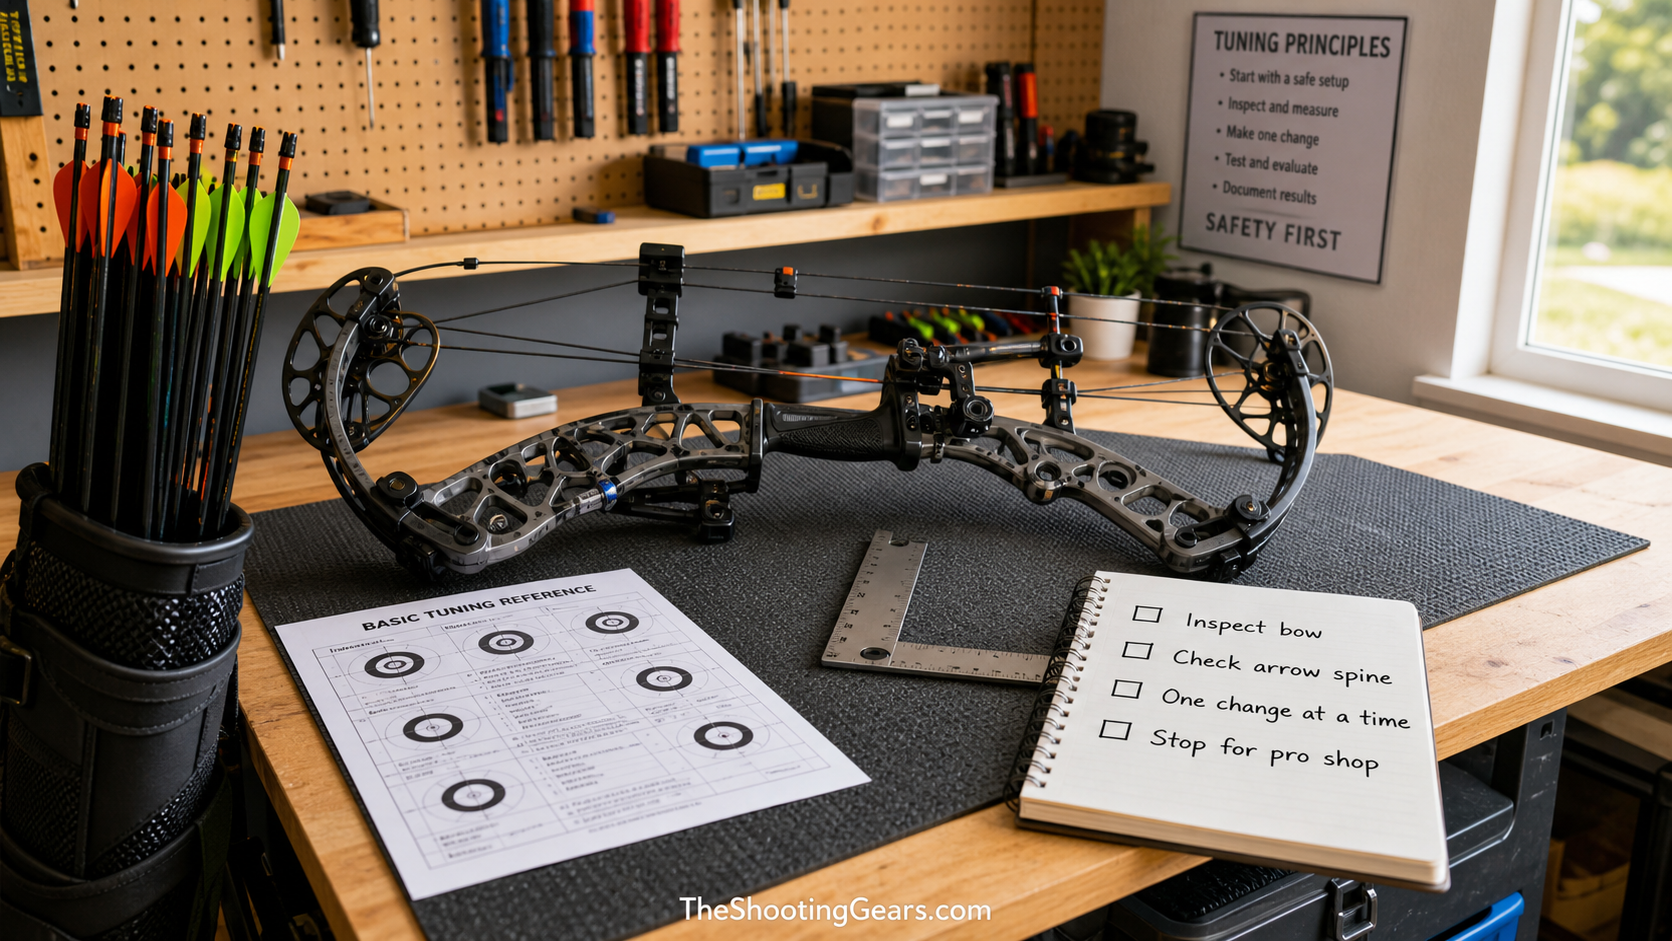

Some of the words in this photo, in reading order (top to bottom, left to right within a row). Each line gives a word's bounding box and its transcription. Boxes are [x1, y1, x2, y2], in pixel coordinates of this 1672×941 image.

[1214, 30, 1278, 53] TUNING
[1285, 33, 1390, 58] PRINCIPLES
[1230, 68, 1255, 83] Start
[1258, 70, 1281, 84] with
[1284, 75, 1290, 84] a
[1294, 72, 1316, 86] safe
[1319, 75, 1349, 91] setup
[1228, 97, 1266, 114] Inspect
[1269, 100, 1289, 114] and
[1292, 104, 1339, 117] measure
[1227, 125, 1254, 140] Make
[1258, 131, 1277, 142] one
[1280, 130, 1319, 149] change
[1225, 153, 1246, 167] Test
[1249, 157, 1269, 170] and
[1272, 159, 1318, 175] evaluate
[1223, 180, 1276, 200] Document
[1280, 190, 1316, 205] results
[1206, 212, 1276, 240] SAFETY
[1284, 224, 1341, 250] FIRST
[362, 614, 420, 631] BASIC
[424, 600, 496, 619] TUNING
[499, 585, 597, 606] REFERENCE
[1187, 613, 1266, 635] Inspect
[1281, 622, 1322, 638] bow
[1174, 650, 1241, 670] Check
[1254, 664, 1320, 677] arrow
[1334, 669, 1392, 687] spine
[1163, 689, 1205, 707] One
[1217, 696, 1292, 723] change
[1303, 706, 1325, 720] at
[1337, 714, 1349, 723] a
[1360, 710, 1410, 729] time
[1151, 730, 1206, 757] Stop
[1221, 738, 1257, 756] for
[1271, 750, 1309, 767] pro
[1324, 750, 1378, 777] shop
